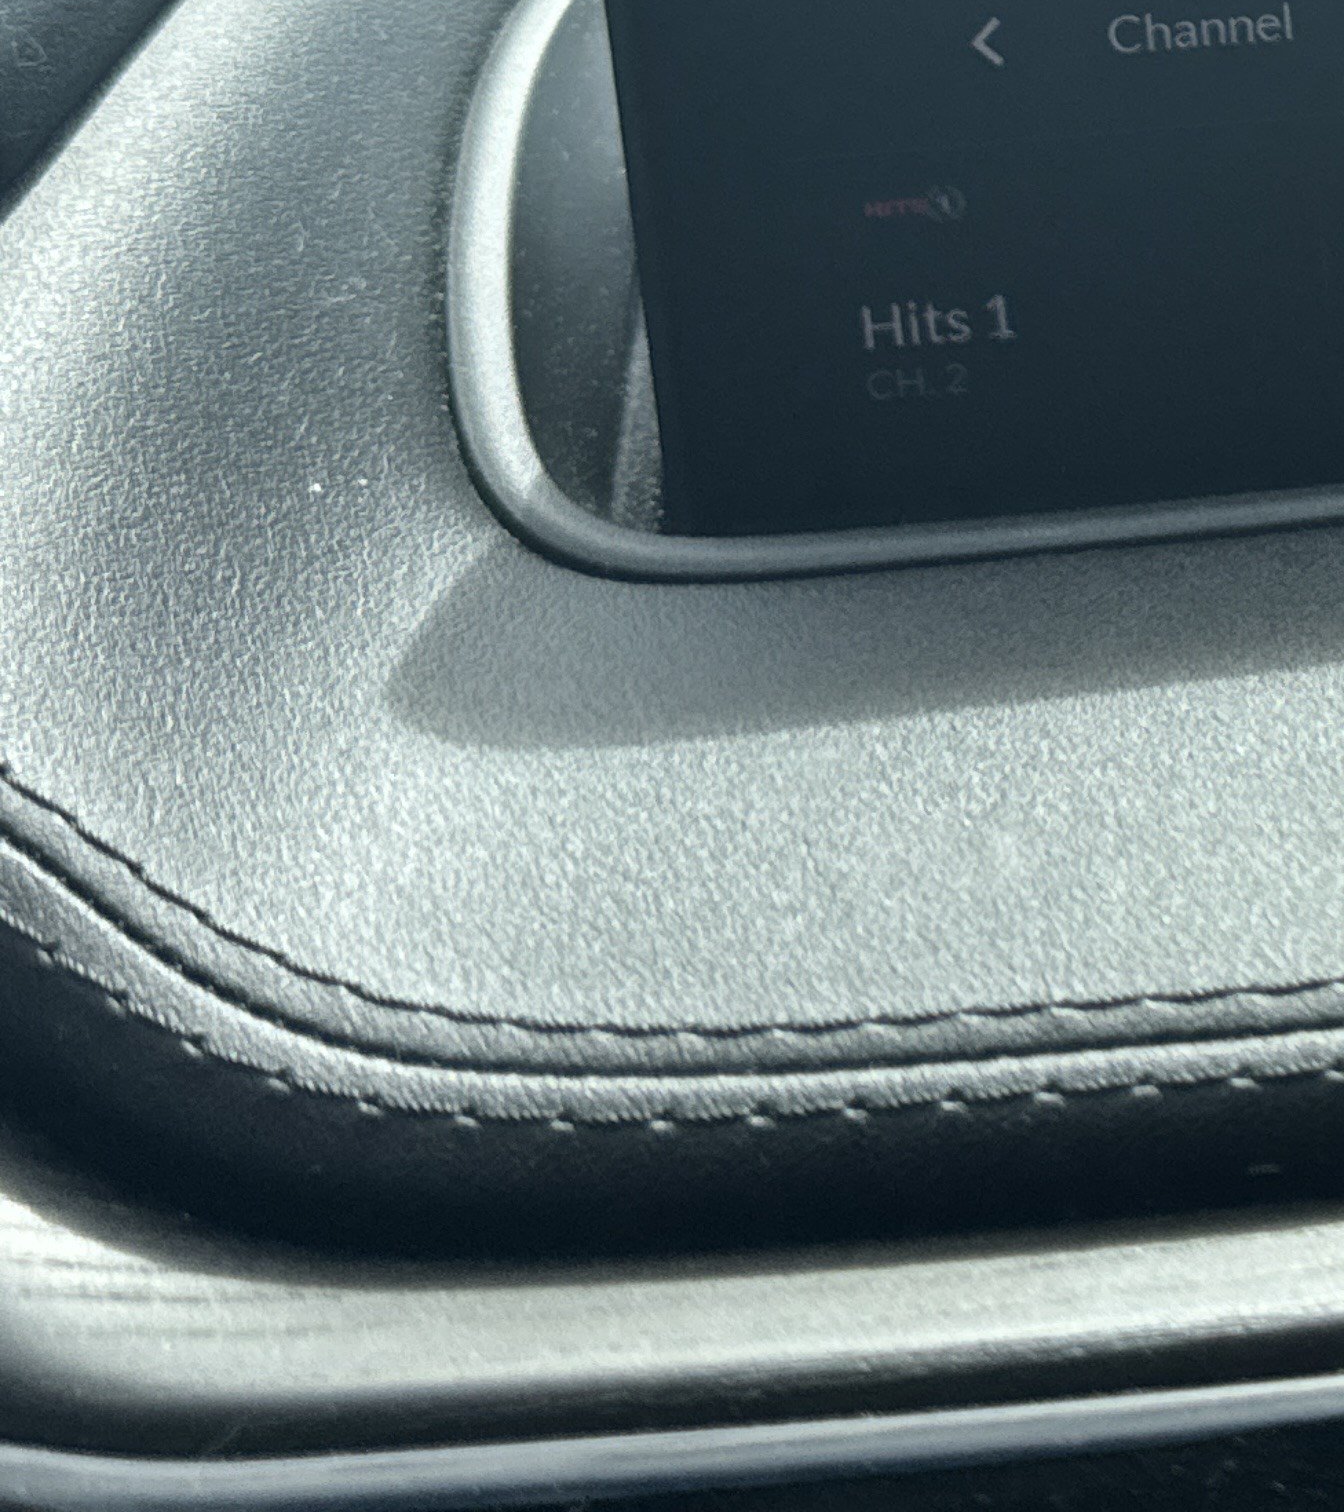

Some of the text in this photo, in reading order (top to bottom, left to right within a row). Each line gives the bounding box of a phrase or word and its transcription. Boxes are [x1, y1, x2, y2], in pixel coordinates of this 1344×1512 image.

[1107, 1, 1295, 53] Channel
[860, 294, 1018, 350] Hits 1
[946, 363, 970, 396] 2
